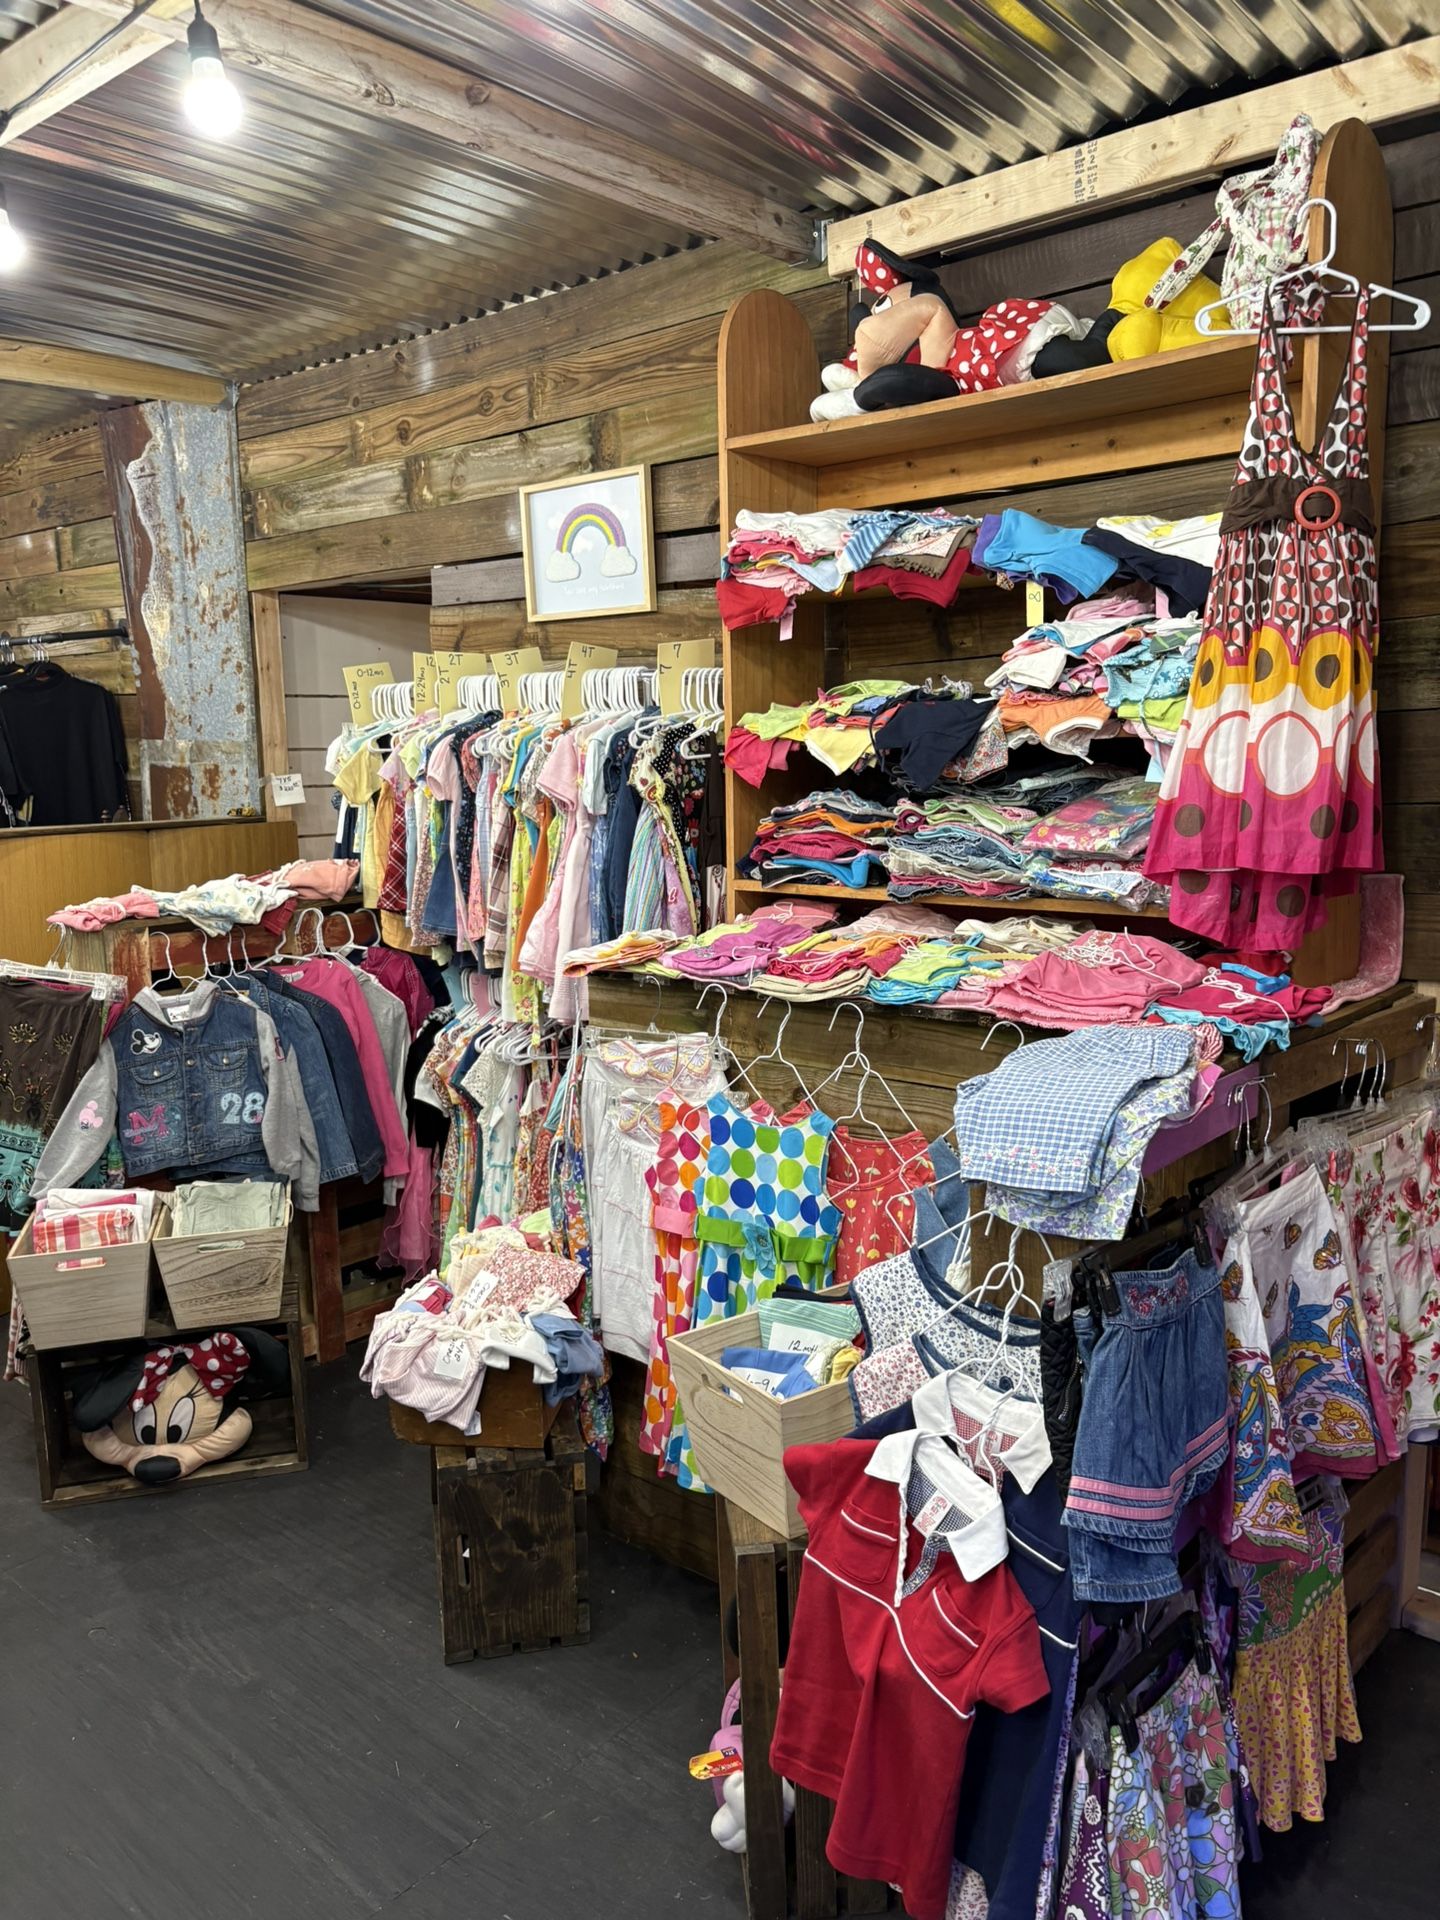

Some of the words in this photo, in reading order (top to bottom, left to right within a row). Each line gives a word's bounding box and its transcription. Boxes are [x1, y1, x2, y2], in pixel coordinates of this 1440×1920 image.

[581, 645, 595, 658] 4T
[673, 643, 682, 658] 7
[448, 653, 463, 666] 2T
[504, 651, 519, 666] 3T
[438, 665, 450, 685] 2T
[566, 658, 577, 678] 4T
[659, 663, 672, 674] 7
[497, 671, 510, 688] 3T
[220, 1091, 265, 1125] 28
[788, 1340, 801, 1351] 12
